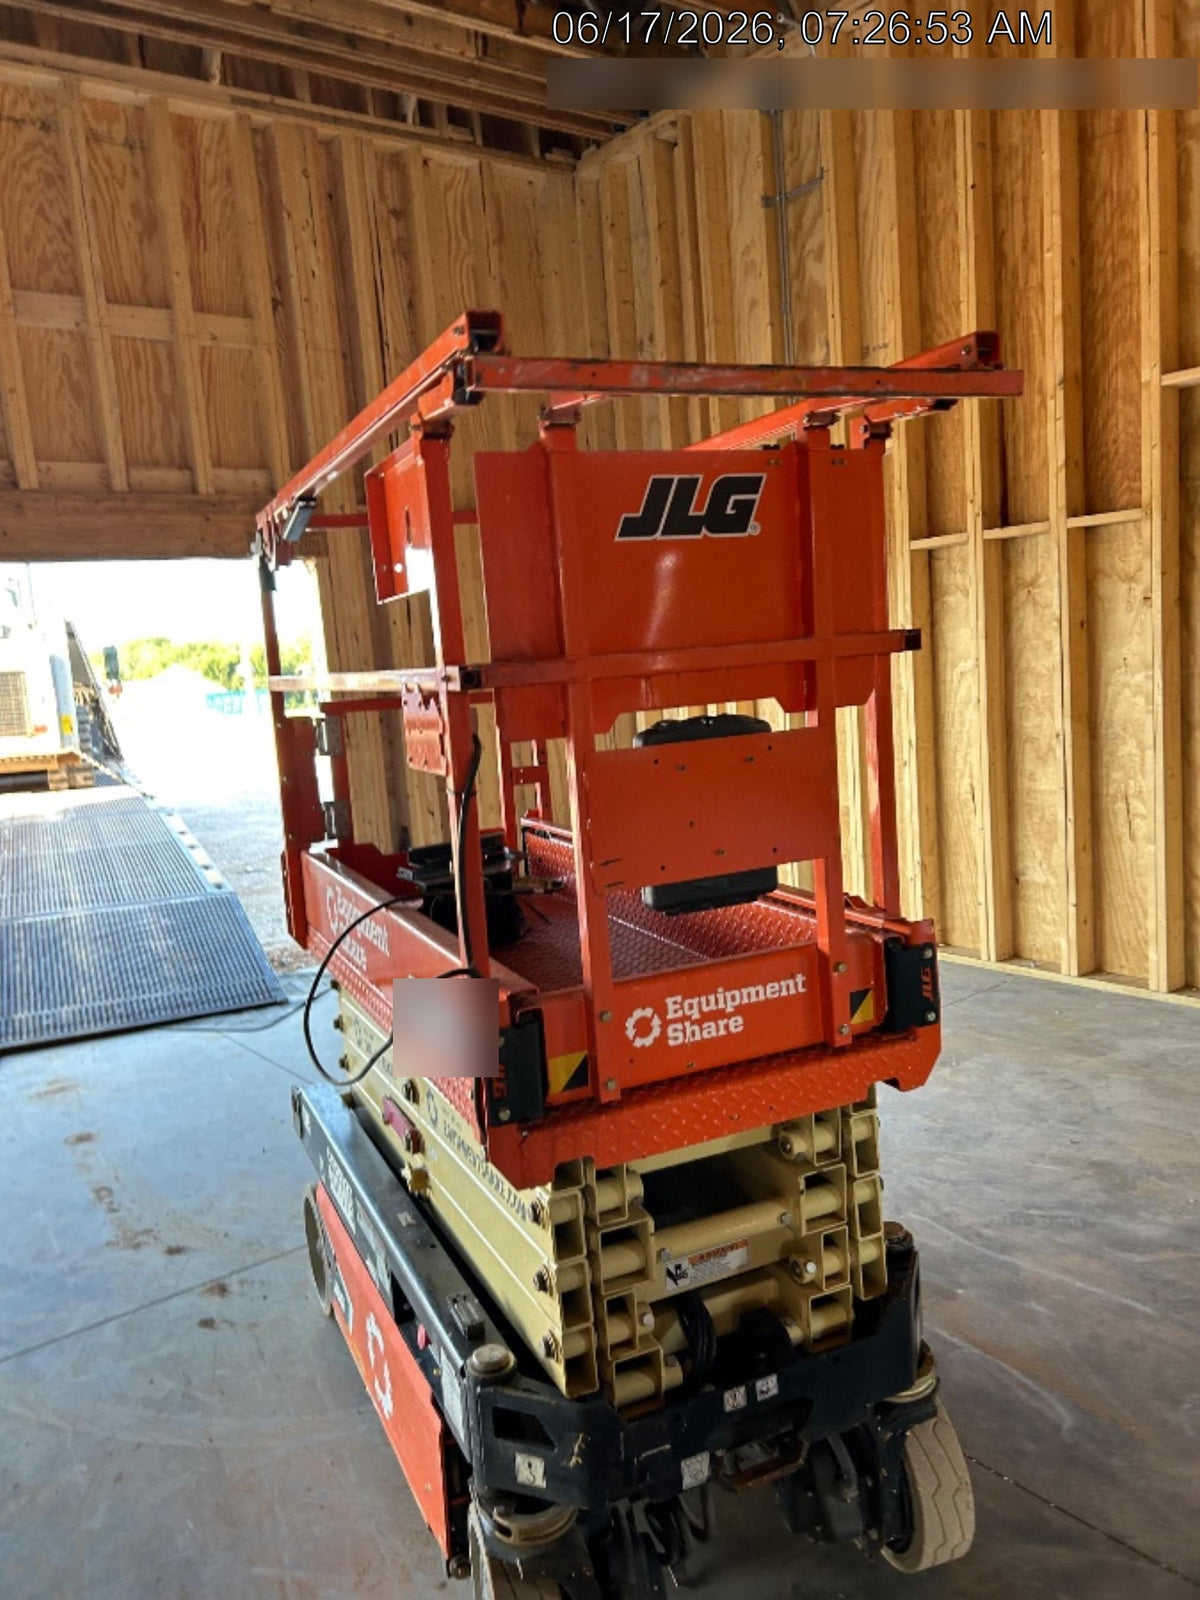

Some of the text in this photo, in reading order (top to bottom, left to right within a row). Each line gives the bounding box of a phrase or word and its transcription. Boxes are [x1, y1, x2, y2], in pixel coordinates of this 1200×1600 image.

[615, 473, 767, 541] JLG
[665, 973, 807, 1020] Equipment
[667, 1015, 744, 1046] Share
